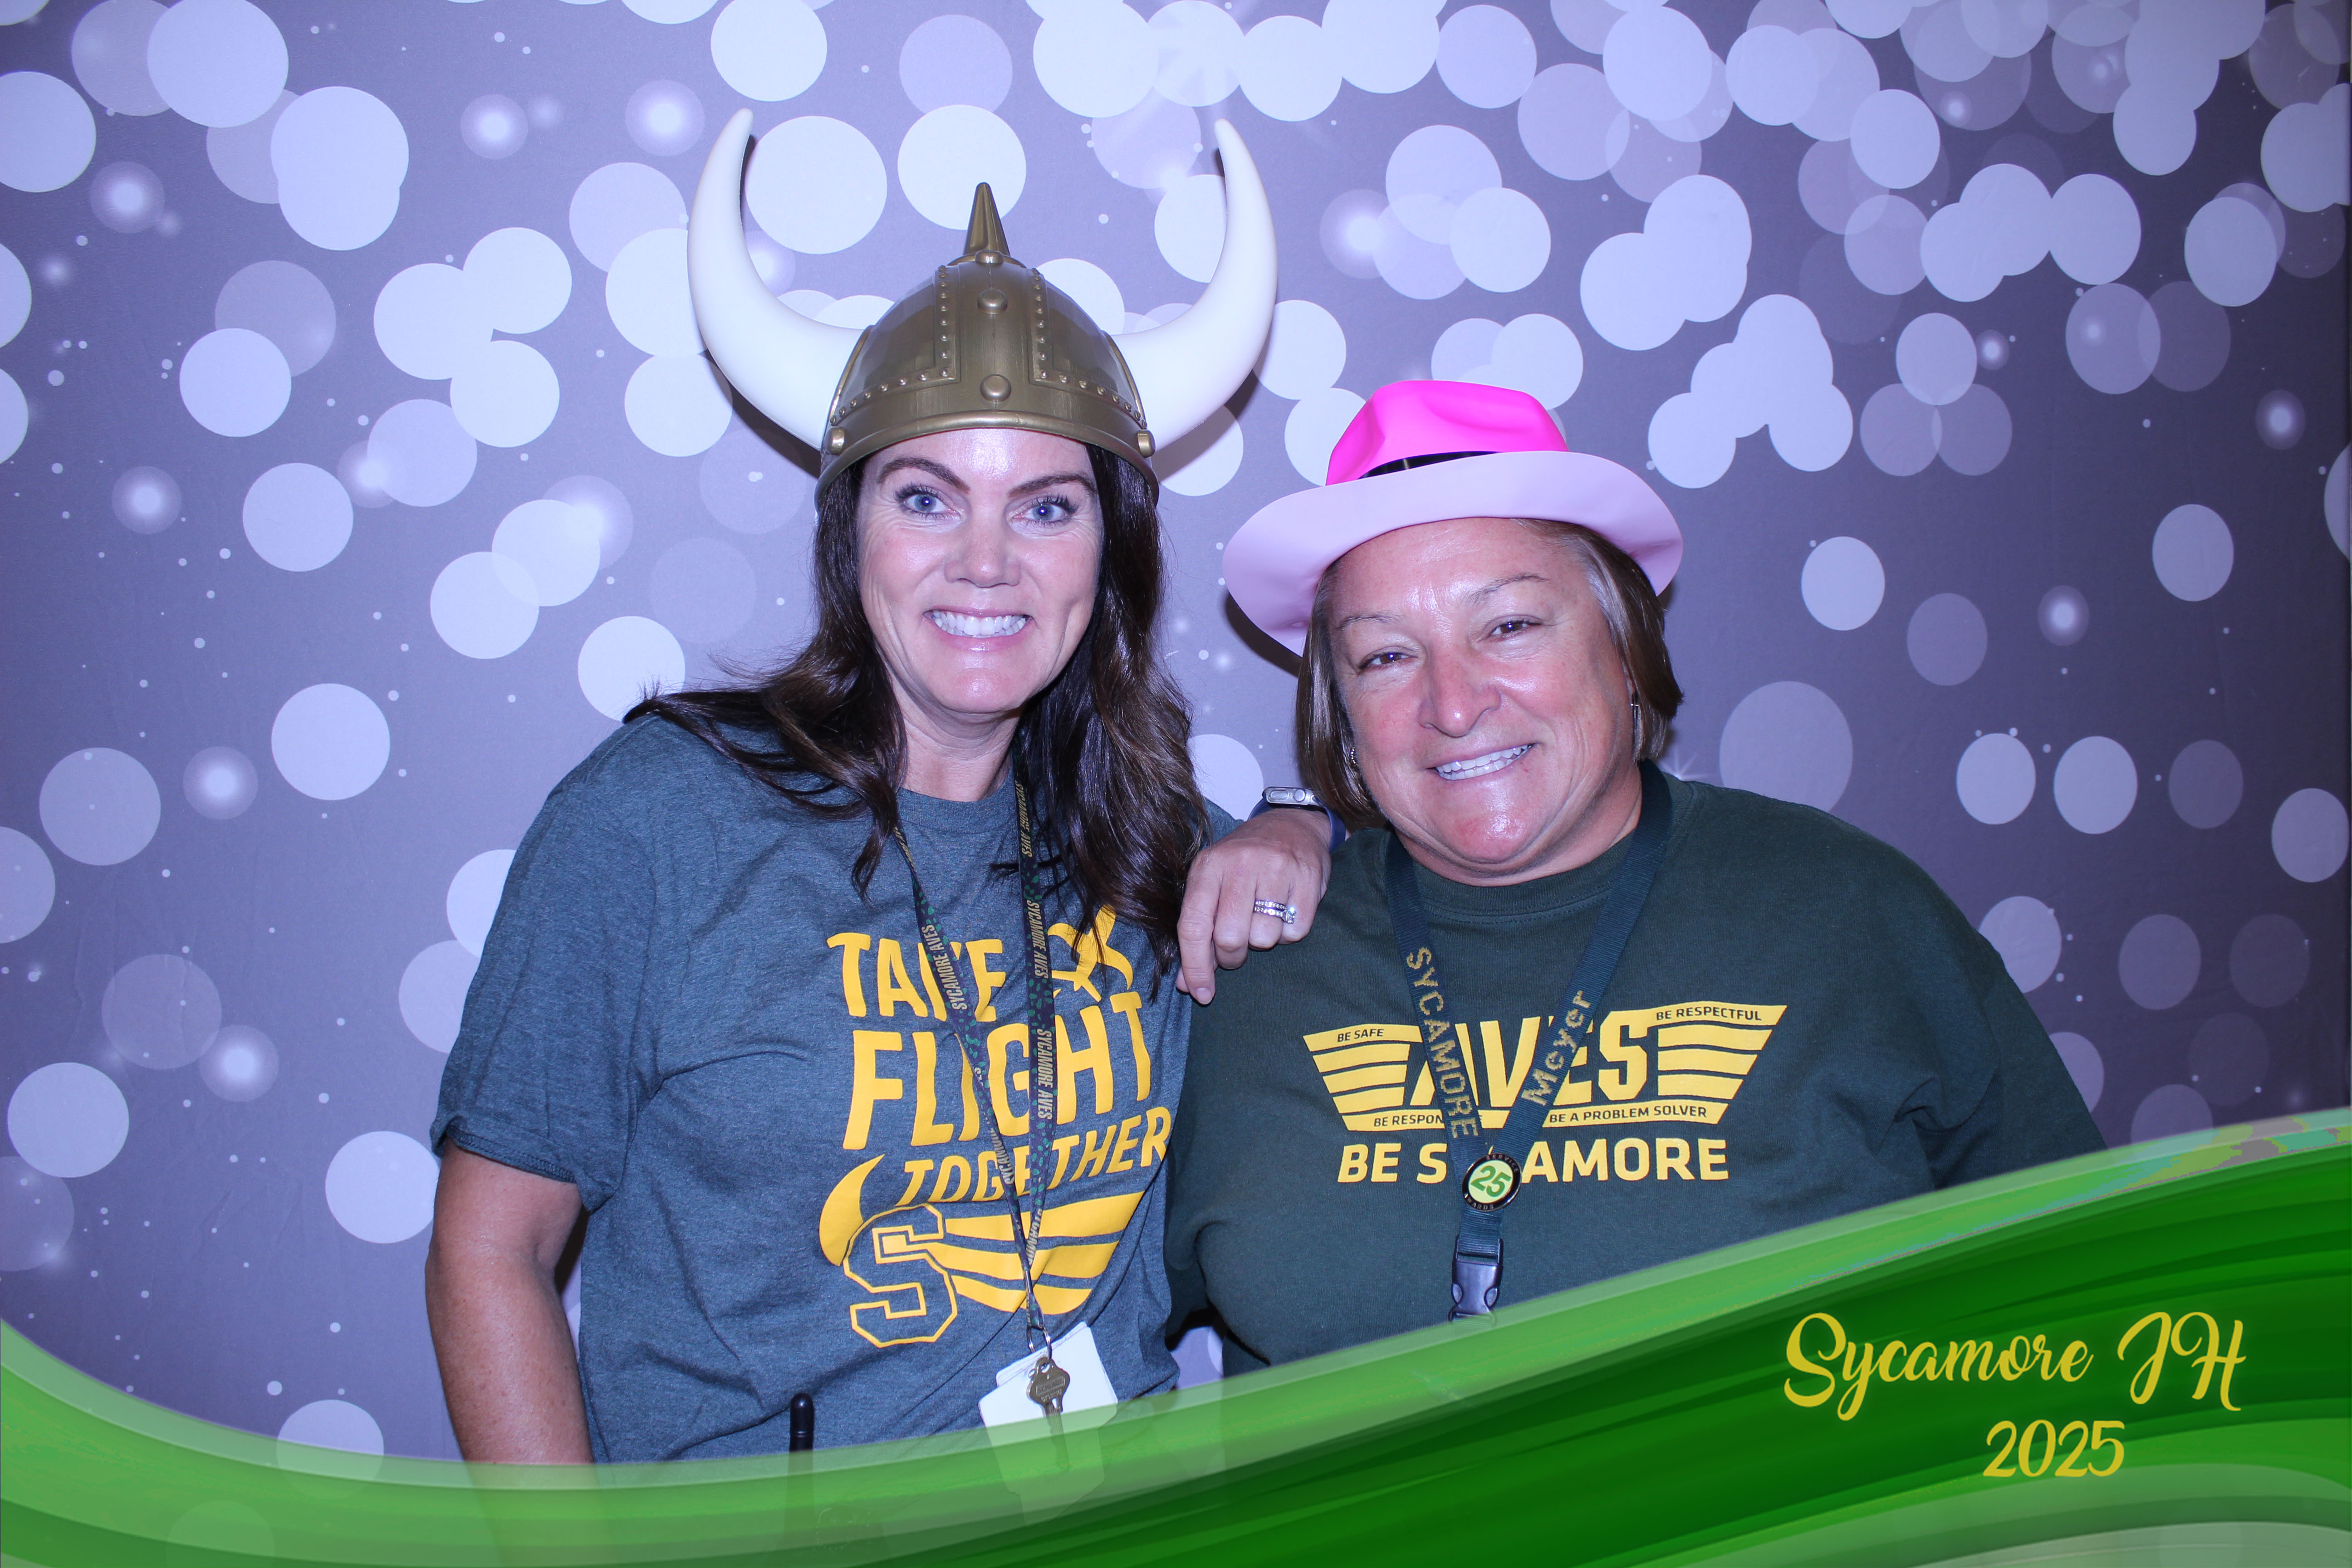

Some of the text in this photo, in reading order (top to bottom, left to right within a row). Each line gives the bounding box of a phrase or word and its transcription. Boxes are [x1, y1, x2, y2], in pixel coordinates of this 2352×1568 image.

[1015, 779, 1033, 858] SYCAMORE AVES
[921, 924, 968, 1011] SYCAMORE AVES
[1027, 899, 1049, 979] SYCAMORE AVES
[1337, 1029, 1385, 1043] BE SAFE
[1406, 947, 1479, 1138] SYCAMORE
[1521, 990, 1591, 1107] Meyer
[1656, 1006, 1762, 1021] BE RESPECTFUL
[842, 992, 1151, 1150] FLIGHT
[1036, 1028, 1054, 1120] SYCAMORE AVES
[1373, 1117, 1388, 1127] BE
[1549, 1105, 1707, 1123] BE A PROBLEM SOLVER
[894, 1106, 1171, 1207] TOGETHER
[1337, 1137, 1729, 1184] BE SAMORE
[1470, 1165, 1512, 1198] 25
[1486, 1154, 1519, 1173] SERVICE
